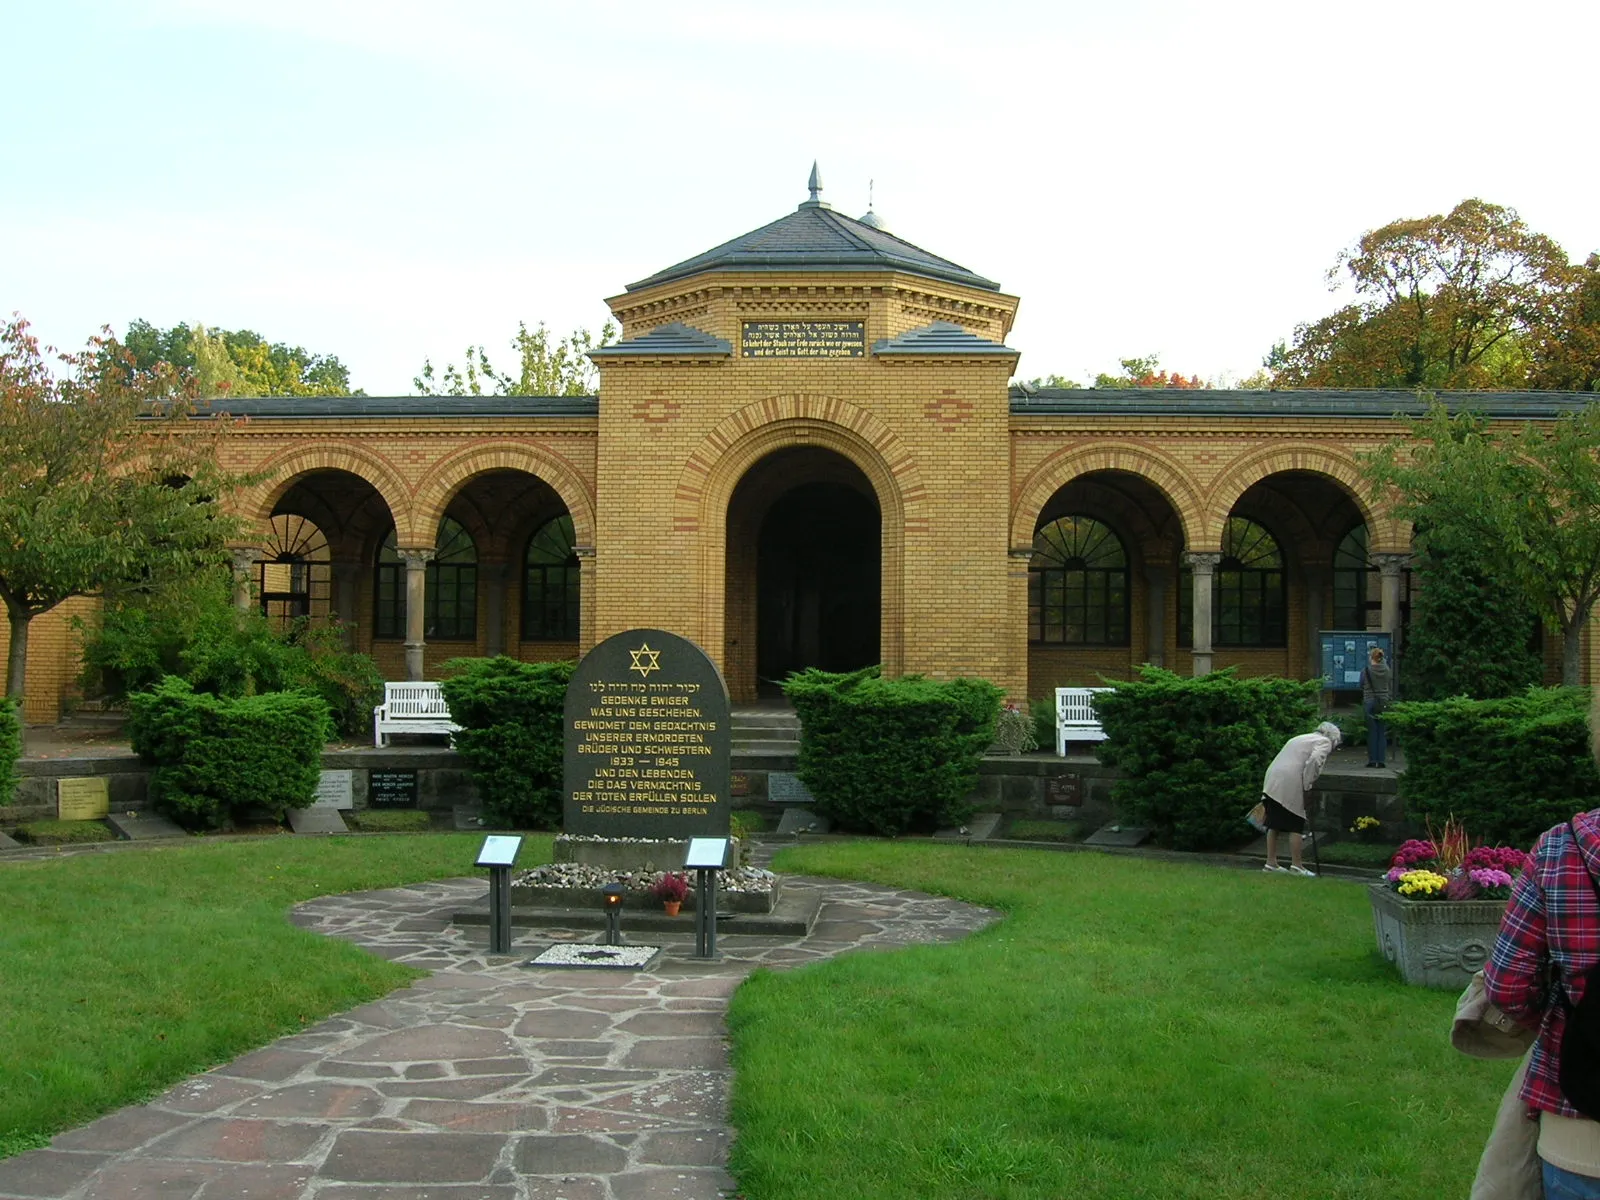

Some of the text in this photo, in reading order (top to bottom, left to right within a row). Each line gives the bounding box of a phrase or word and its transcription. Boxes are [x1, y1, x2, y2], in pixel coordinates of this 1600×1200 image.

[797, 339, 808, 347] Erde
[601, 696, 688, 705] GEDENKE EWIGER
[591, 708, 702, 717] WAS UNS GESCHEHEN.
[574, 721, 625, 730] GEWIDMET
[629, 722, 650, 730] DEM
[585, 733, 703, 742] UNSERER ERMORDETEN
[578, 743, 712, 754] BRÜDER UND SCHWESTERN
[610, 757, 634, 765] 1933
[656, 758, 679, 766] 1945
[595, 769, 694, 778] UND DEN LEBENDEN
[588, 781, 604, 789] DIE
[607, 781, 627, 789] DAS
[573, 791, 716, 802] DER TOTEN ERFÜLLEN SOLLEN
[596, 805, 630, 813] JÜDISCHE
[633, 806, 668, 814] GEMEINDE
